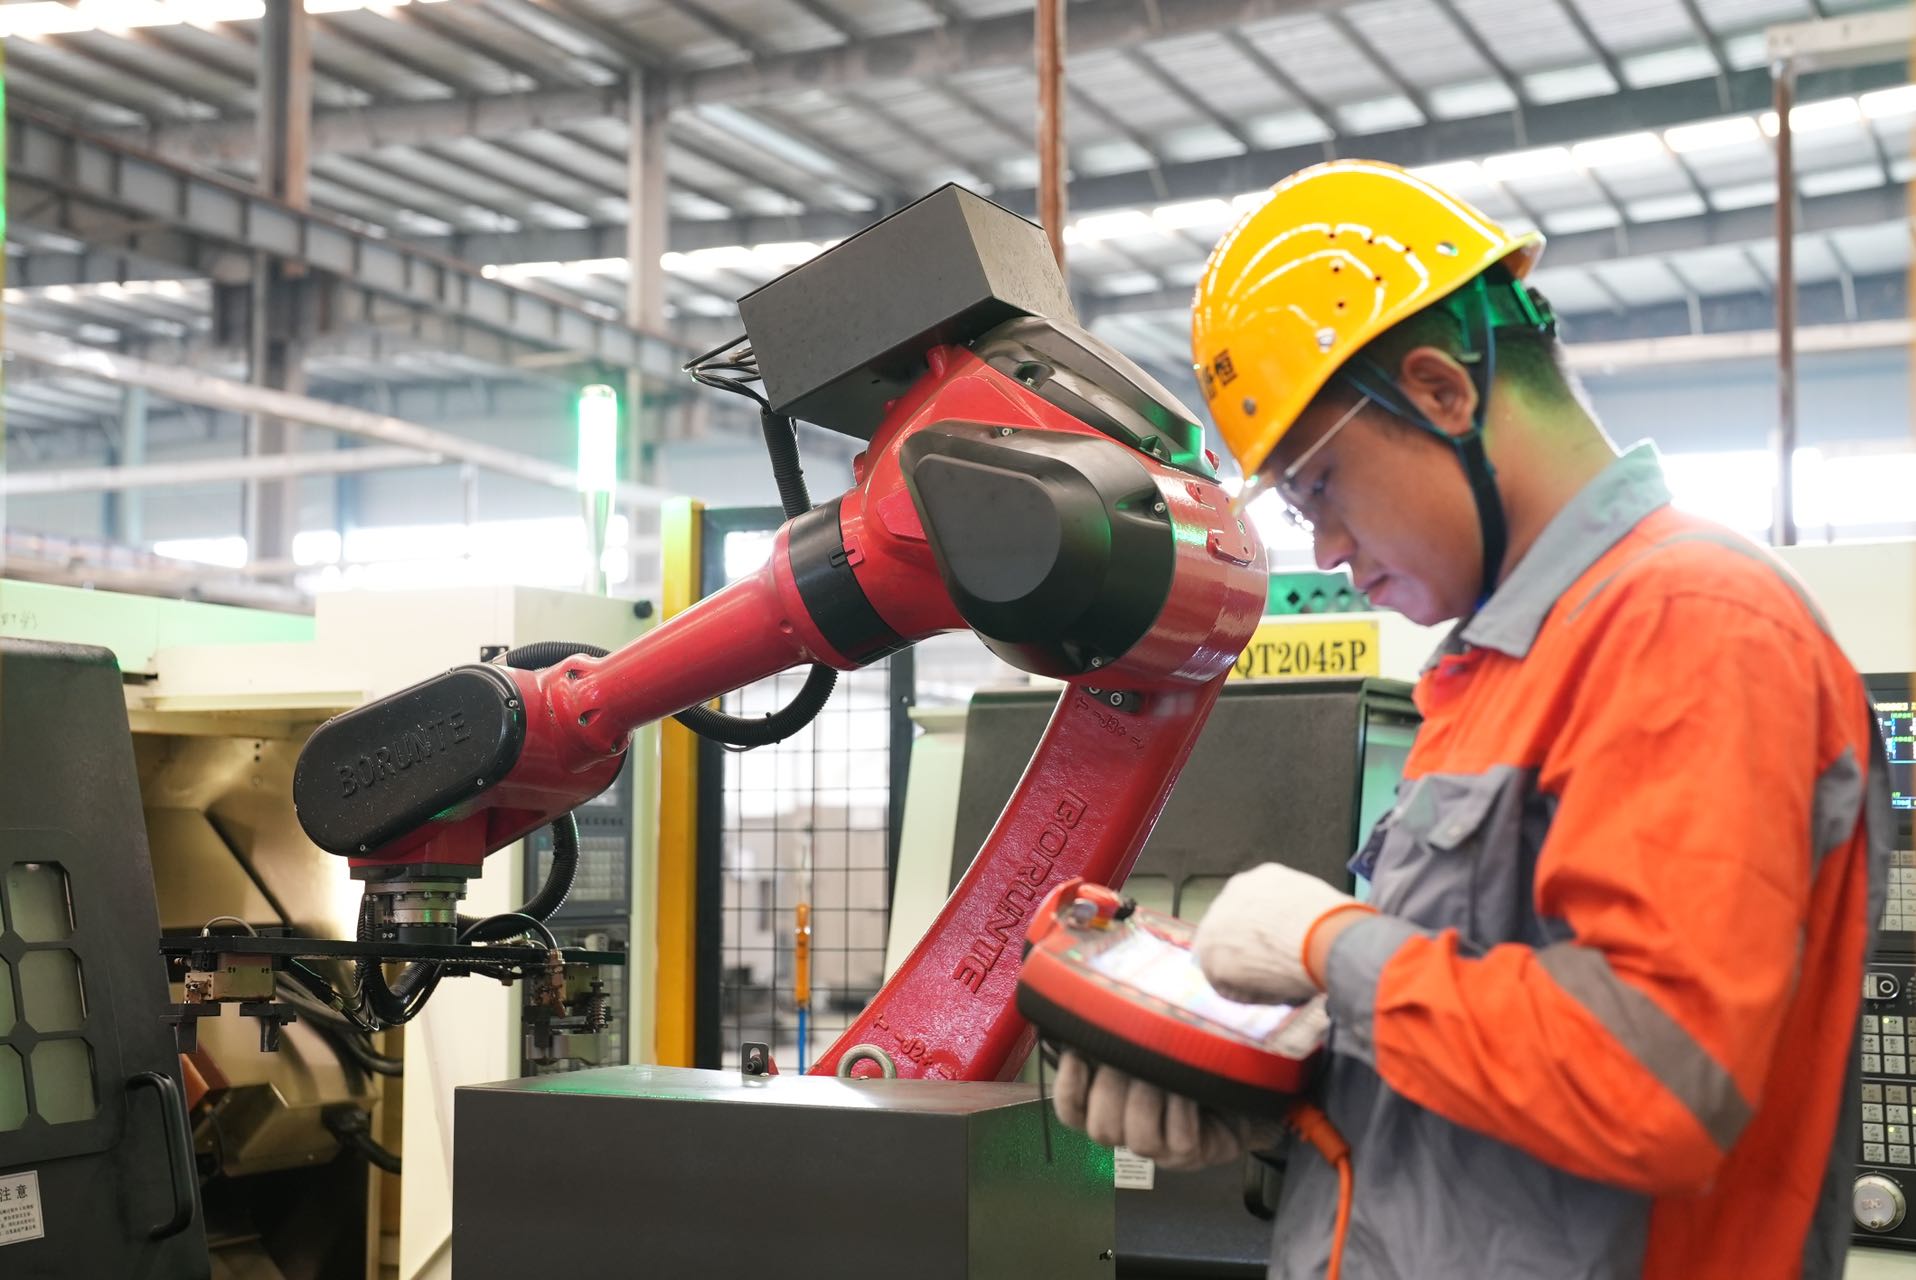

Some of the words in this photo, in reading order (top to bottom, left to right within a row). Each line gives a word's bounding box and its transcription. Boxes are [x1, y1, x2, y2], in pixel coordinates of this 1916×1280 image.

[1235, 639, 1367, 678] QT2045P
[339, 711, 471, 797] BORUNTE
[953, 789, 1087, 994] BORUNTE
